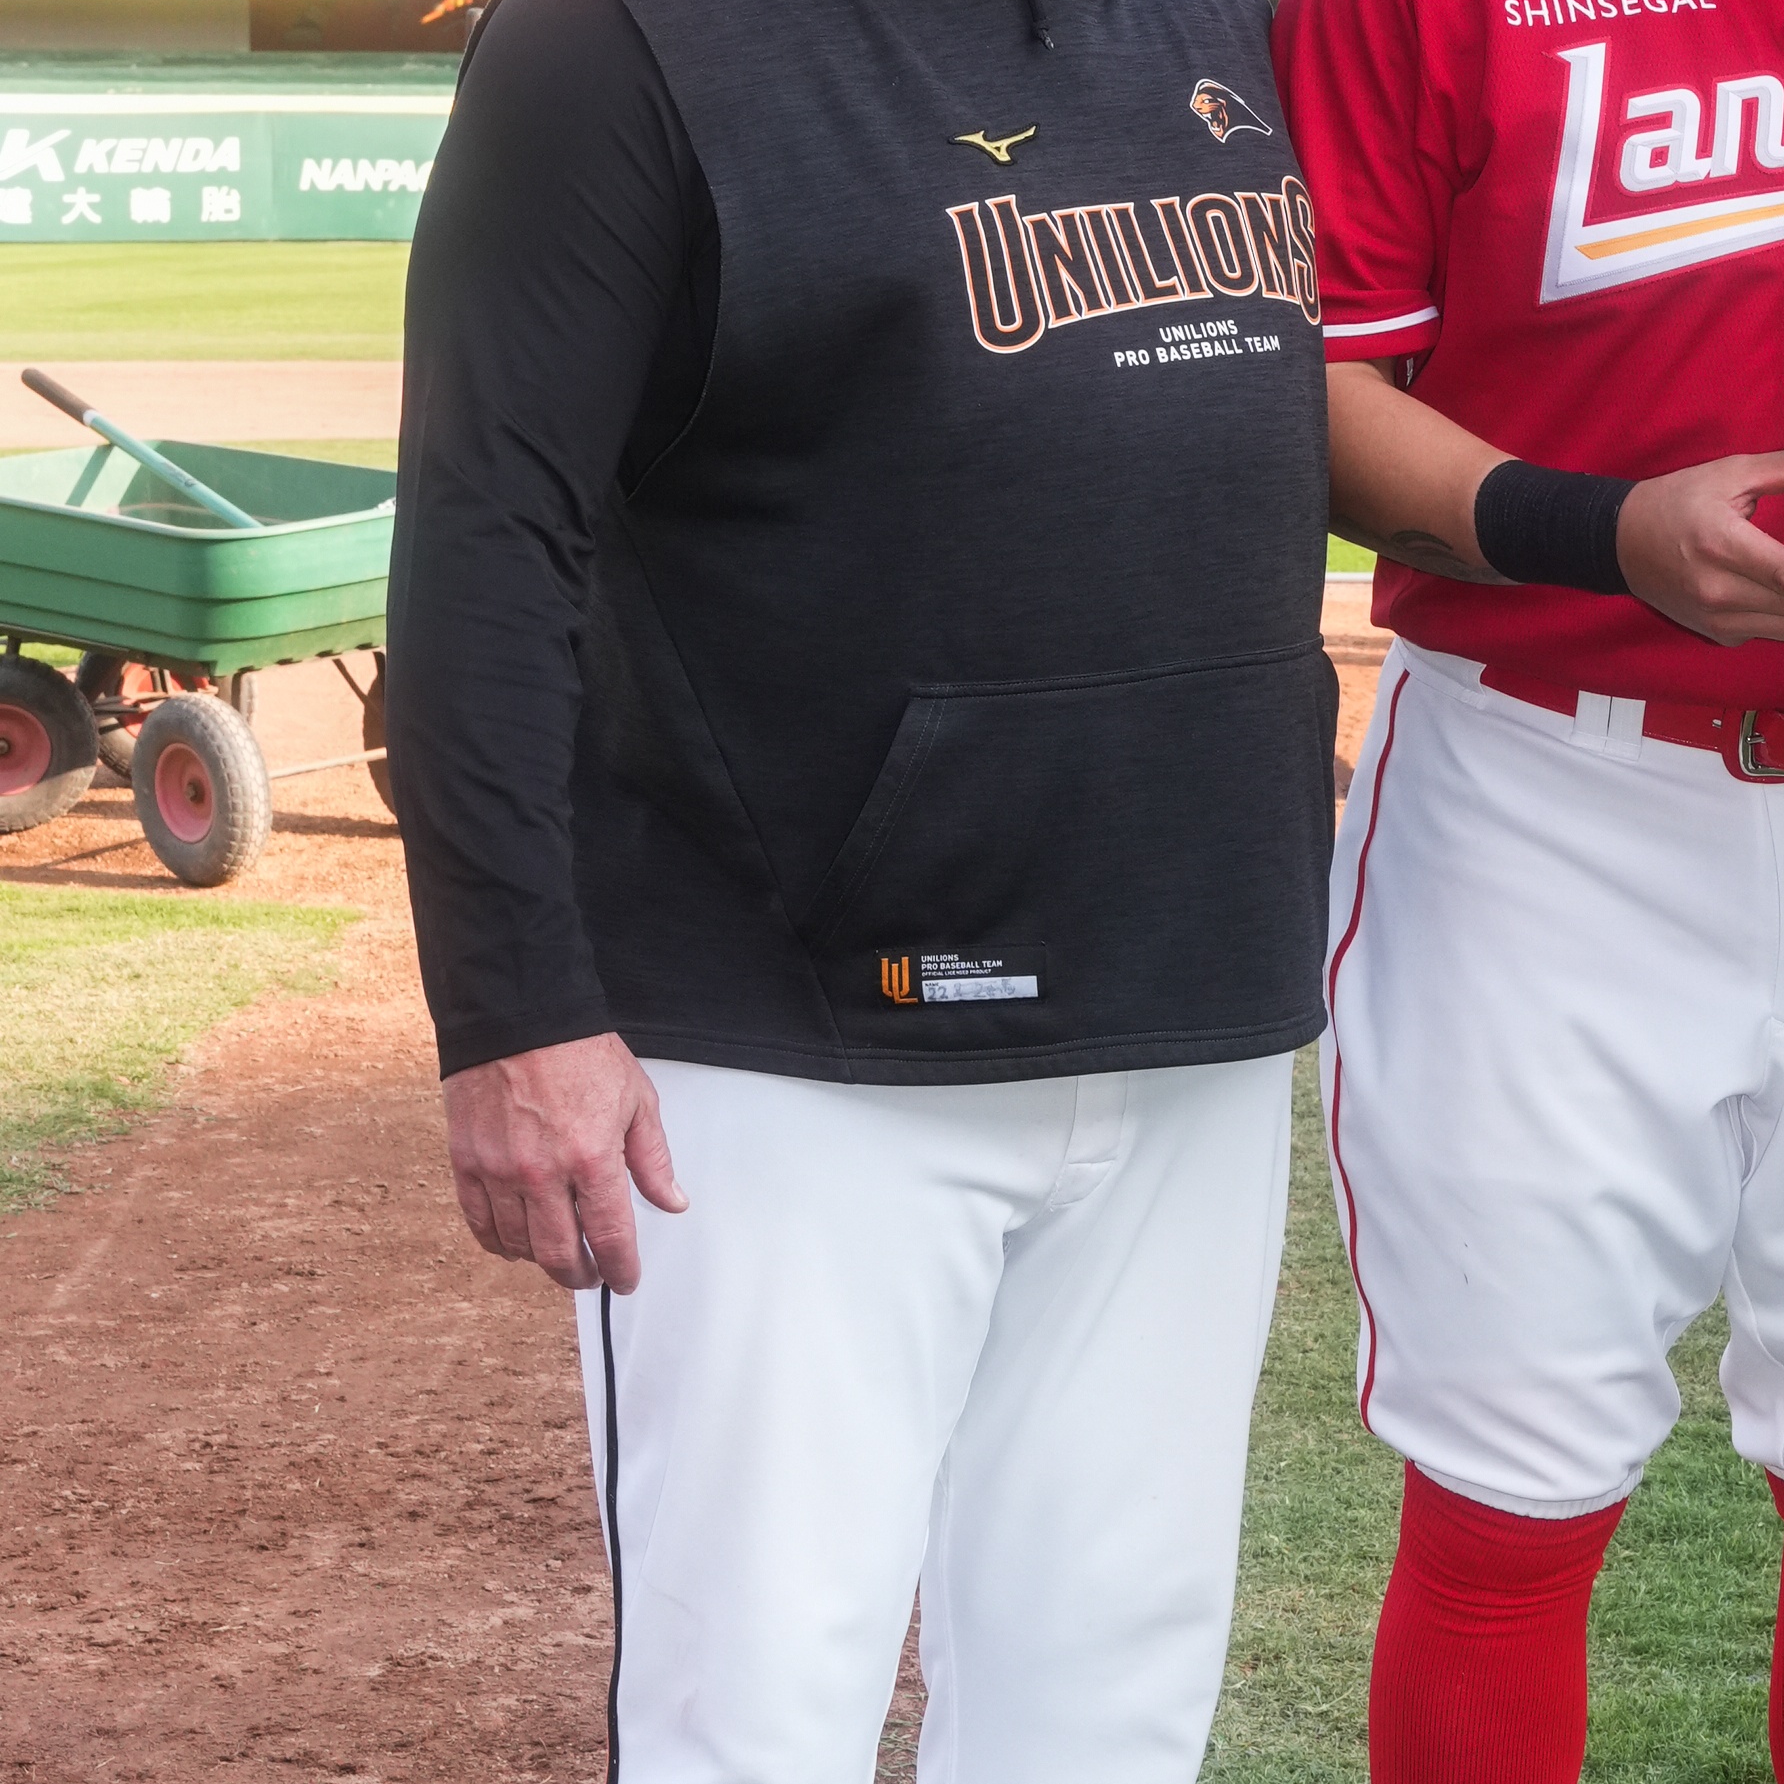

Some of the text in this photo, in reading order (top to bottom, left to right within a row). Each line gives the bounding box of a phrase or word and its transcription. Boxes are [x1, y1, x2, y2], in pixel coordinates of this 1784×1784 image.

[74, 136, 241, 174] KENDA
[945, 176, 1322, 354] UNILIONS
[1159, 319, 1239, 343] UNILIONS
[1114, 335, 1281, 368] PRO BASEBALL TEAM
[921, 954, 959, 963] UNILIONS
[921, 959, 1003, 972] PRO BASEBALL TEAM
